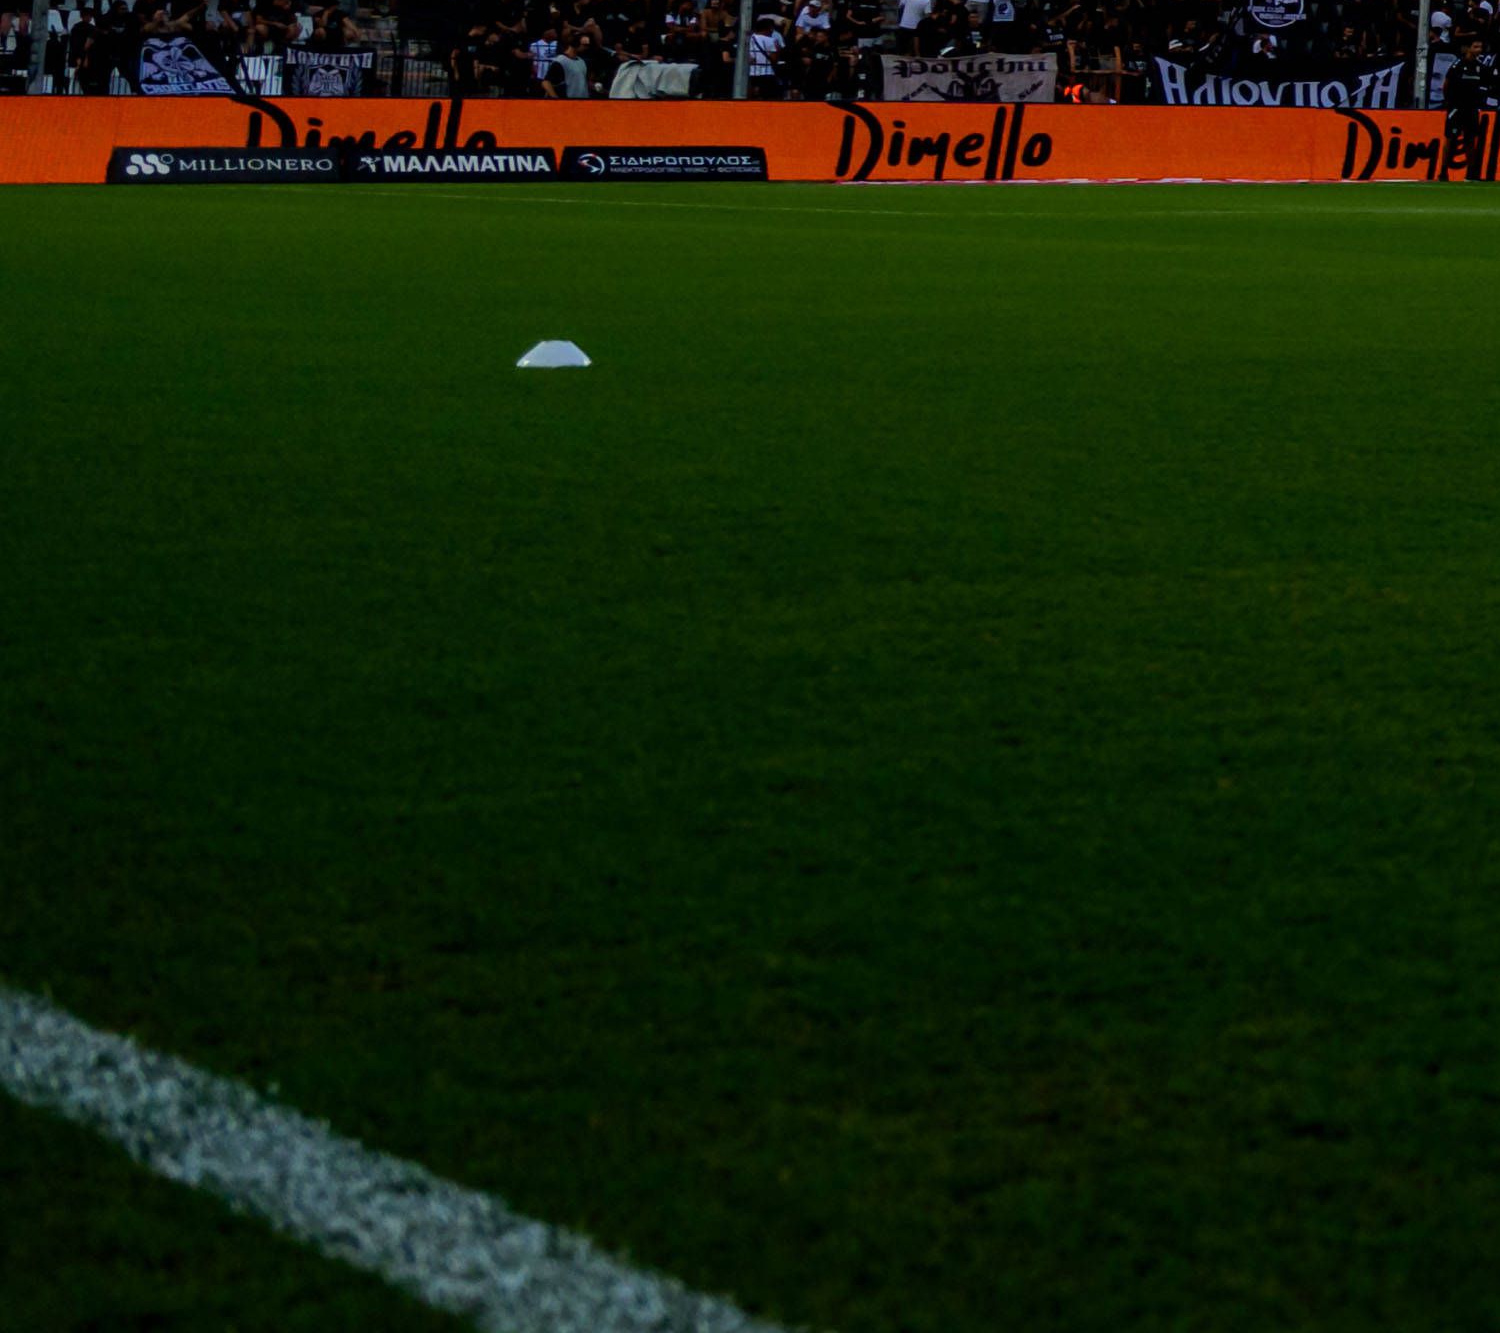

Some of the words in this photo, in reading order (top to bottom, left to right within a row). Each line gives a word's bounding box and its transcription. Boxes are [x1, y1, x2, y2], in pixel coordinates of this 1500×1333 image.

[825, 100, 1052, 181] Dimello
[178, 158, 334, 172] MILLIONERO
[383, 154, 551, 173] ΜΑΛΑΜΑΤΙΝΑ
[608, 155, 752, 166] ΣΙΔΗΡΟΠΟΥΛΟΣ
